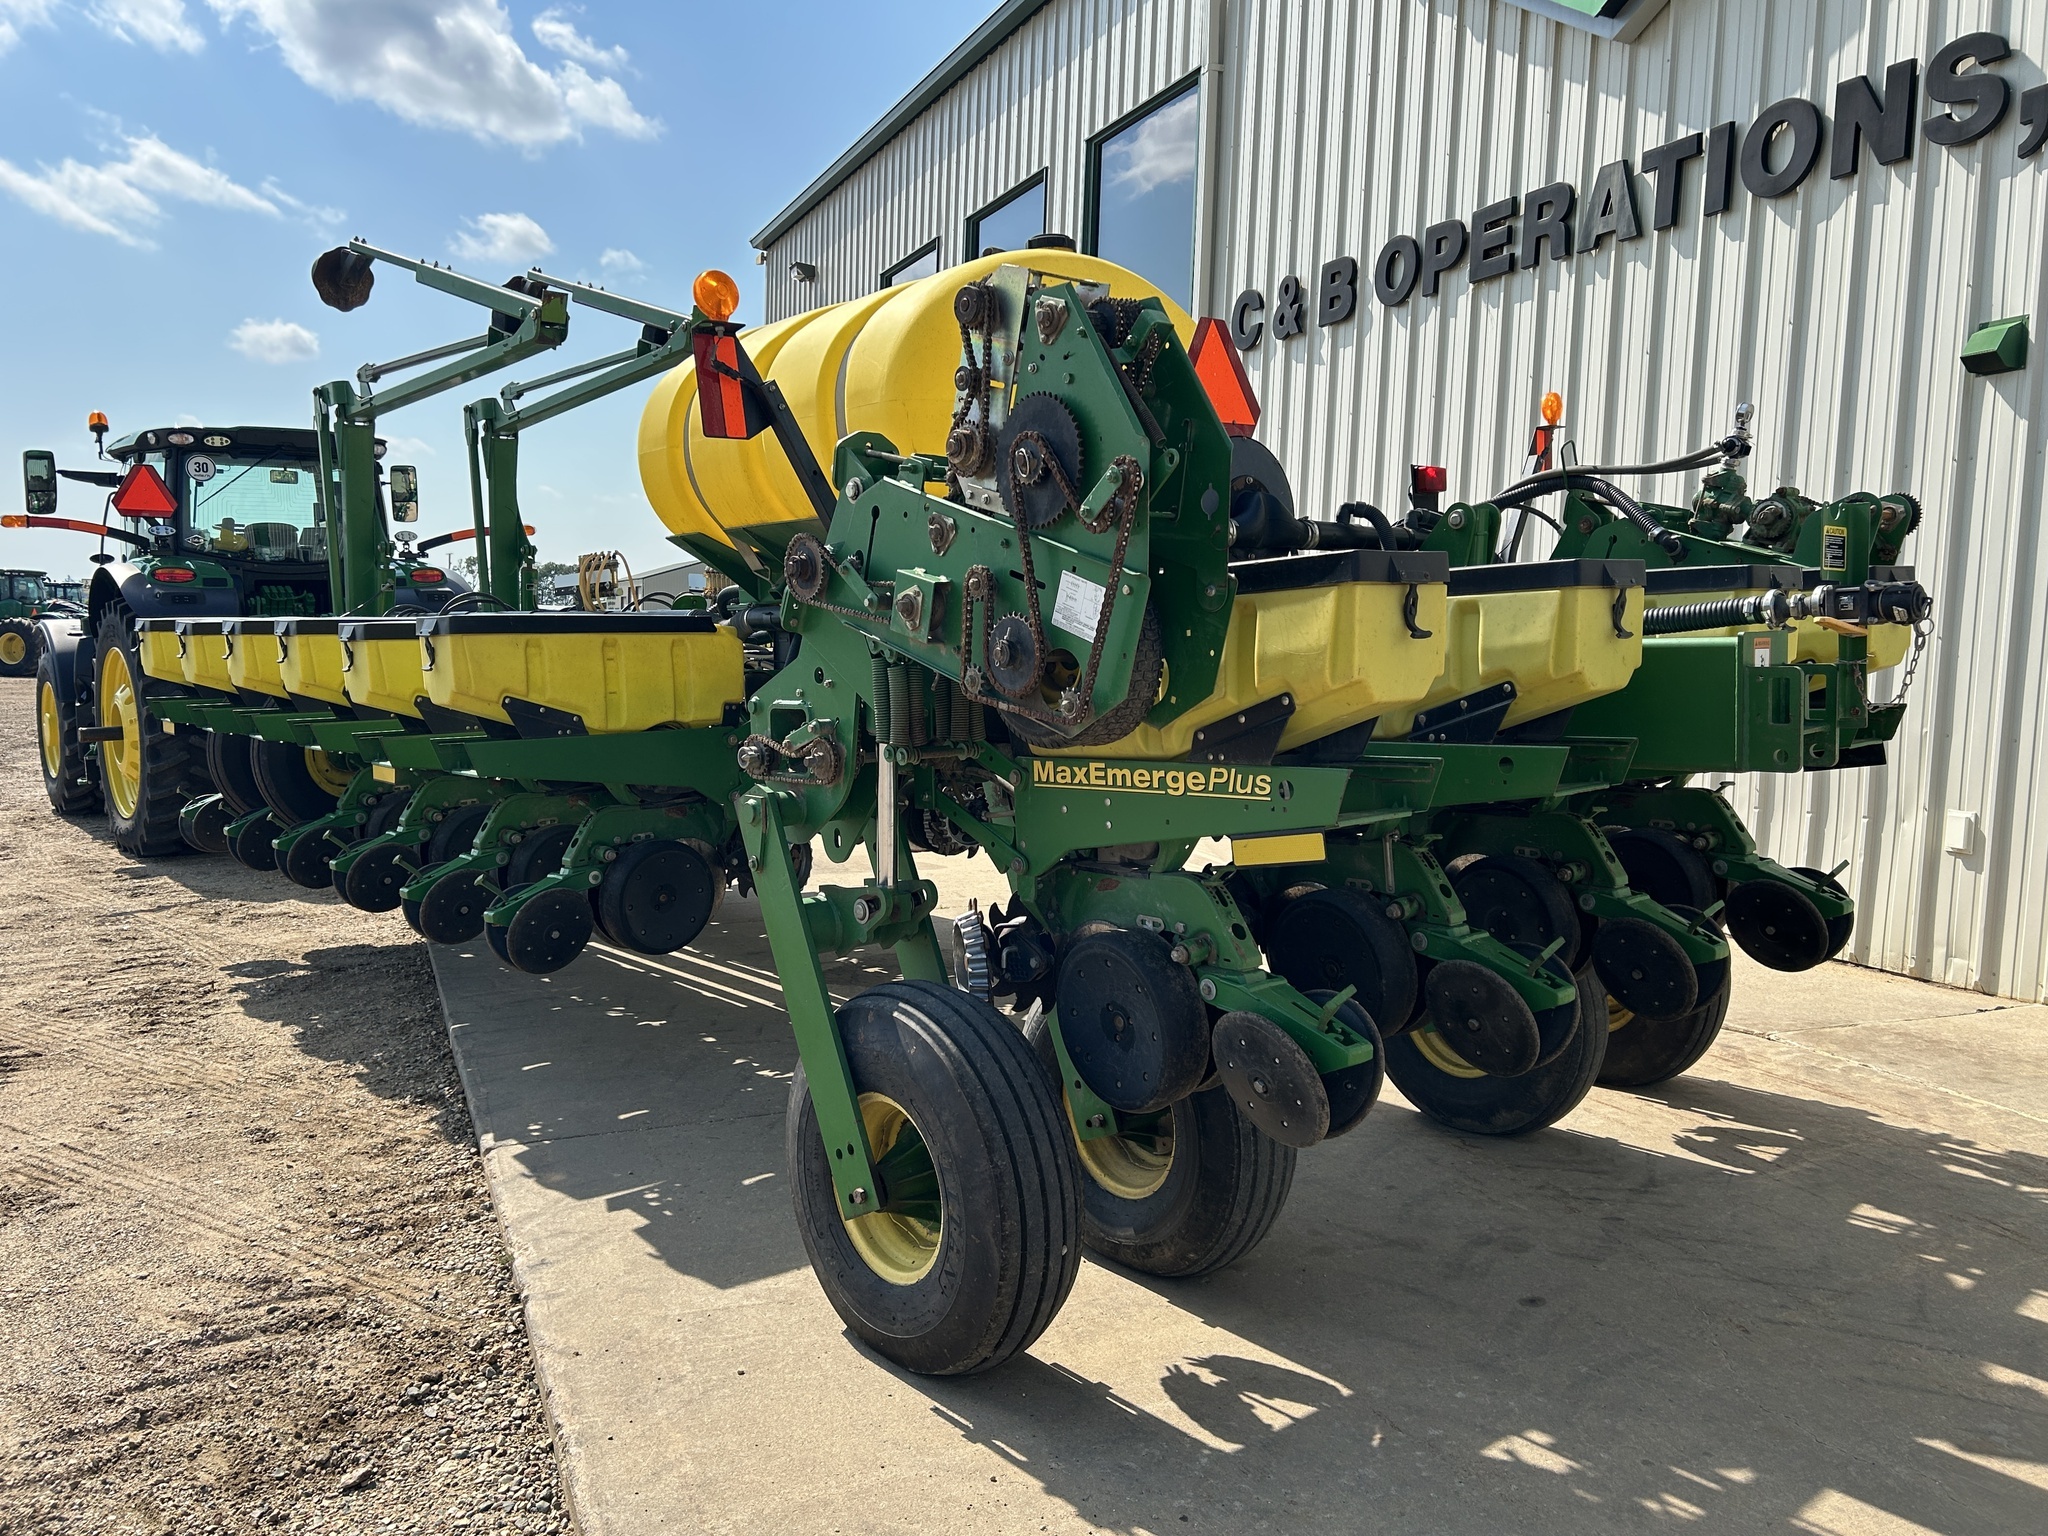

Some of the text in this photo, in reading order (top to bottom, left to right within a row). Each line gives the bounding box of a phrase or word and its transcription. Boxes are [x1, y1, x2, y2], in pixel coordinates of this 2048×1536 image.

[1232, 289, 1265, 351] C
[1273, 274, 1303, 340] &
[1318, 256, 1358, 327] B
[193, 461, 209, 473] 30
